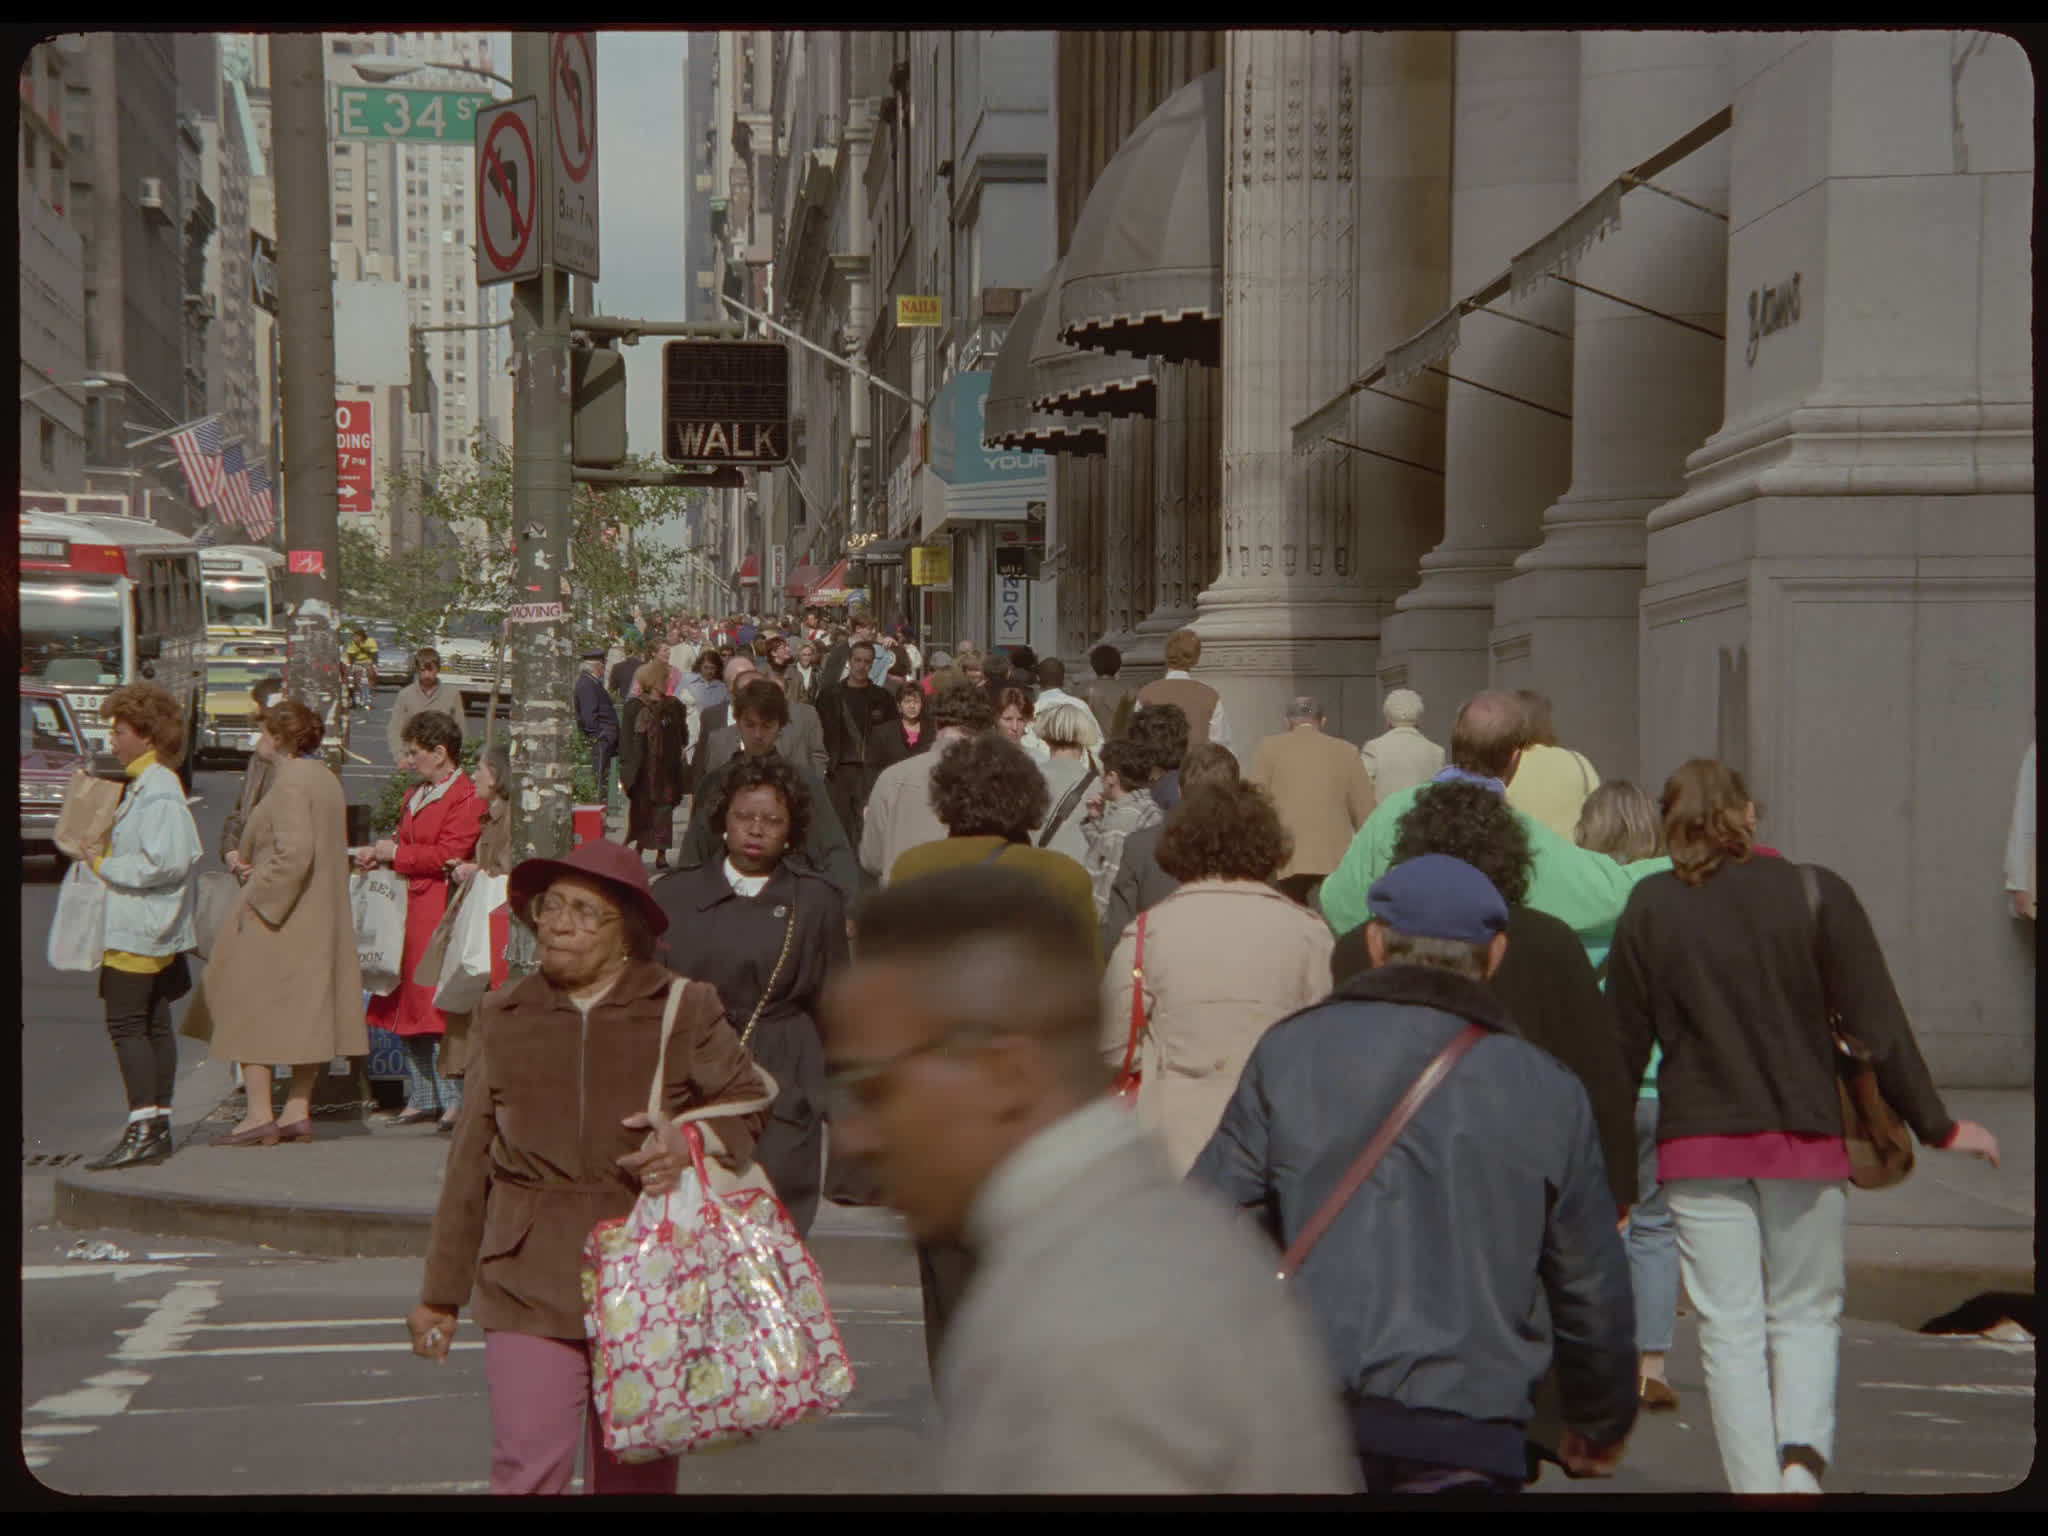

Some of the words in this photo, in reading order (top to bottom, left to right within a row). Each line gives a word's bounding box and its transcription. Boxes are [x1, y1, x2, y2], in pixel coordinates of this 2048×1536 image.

[343, 92, 368, 134] E
[383, 93, 446, 137] 34
[901, 301, 938, 313] NAILS
[336, 407, 351, 429] O
[336, 433, 371, 449] DING
[677, 422, 779, 457] WALK
[512, 605, 560, 618] MOVING
